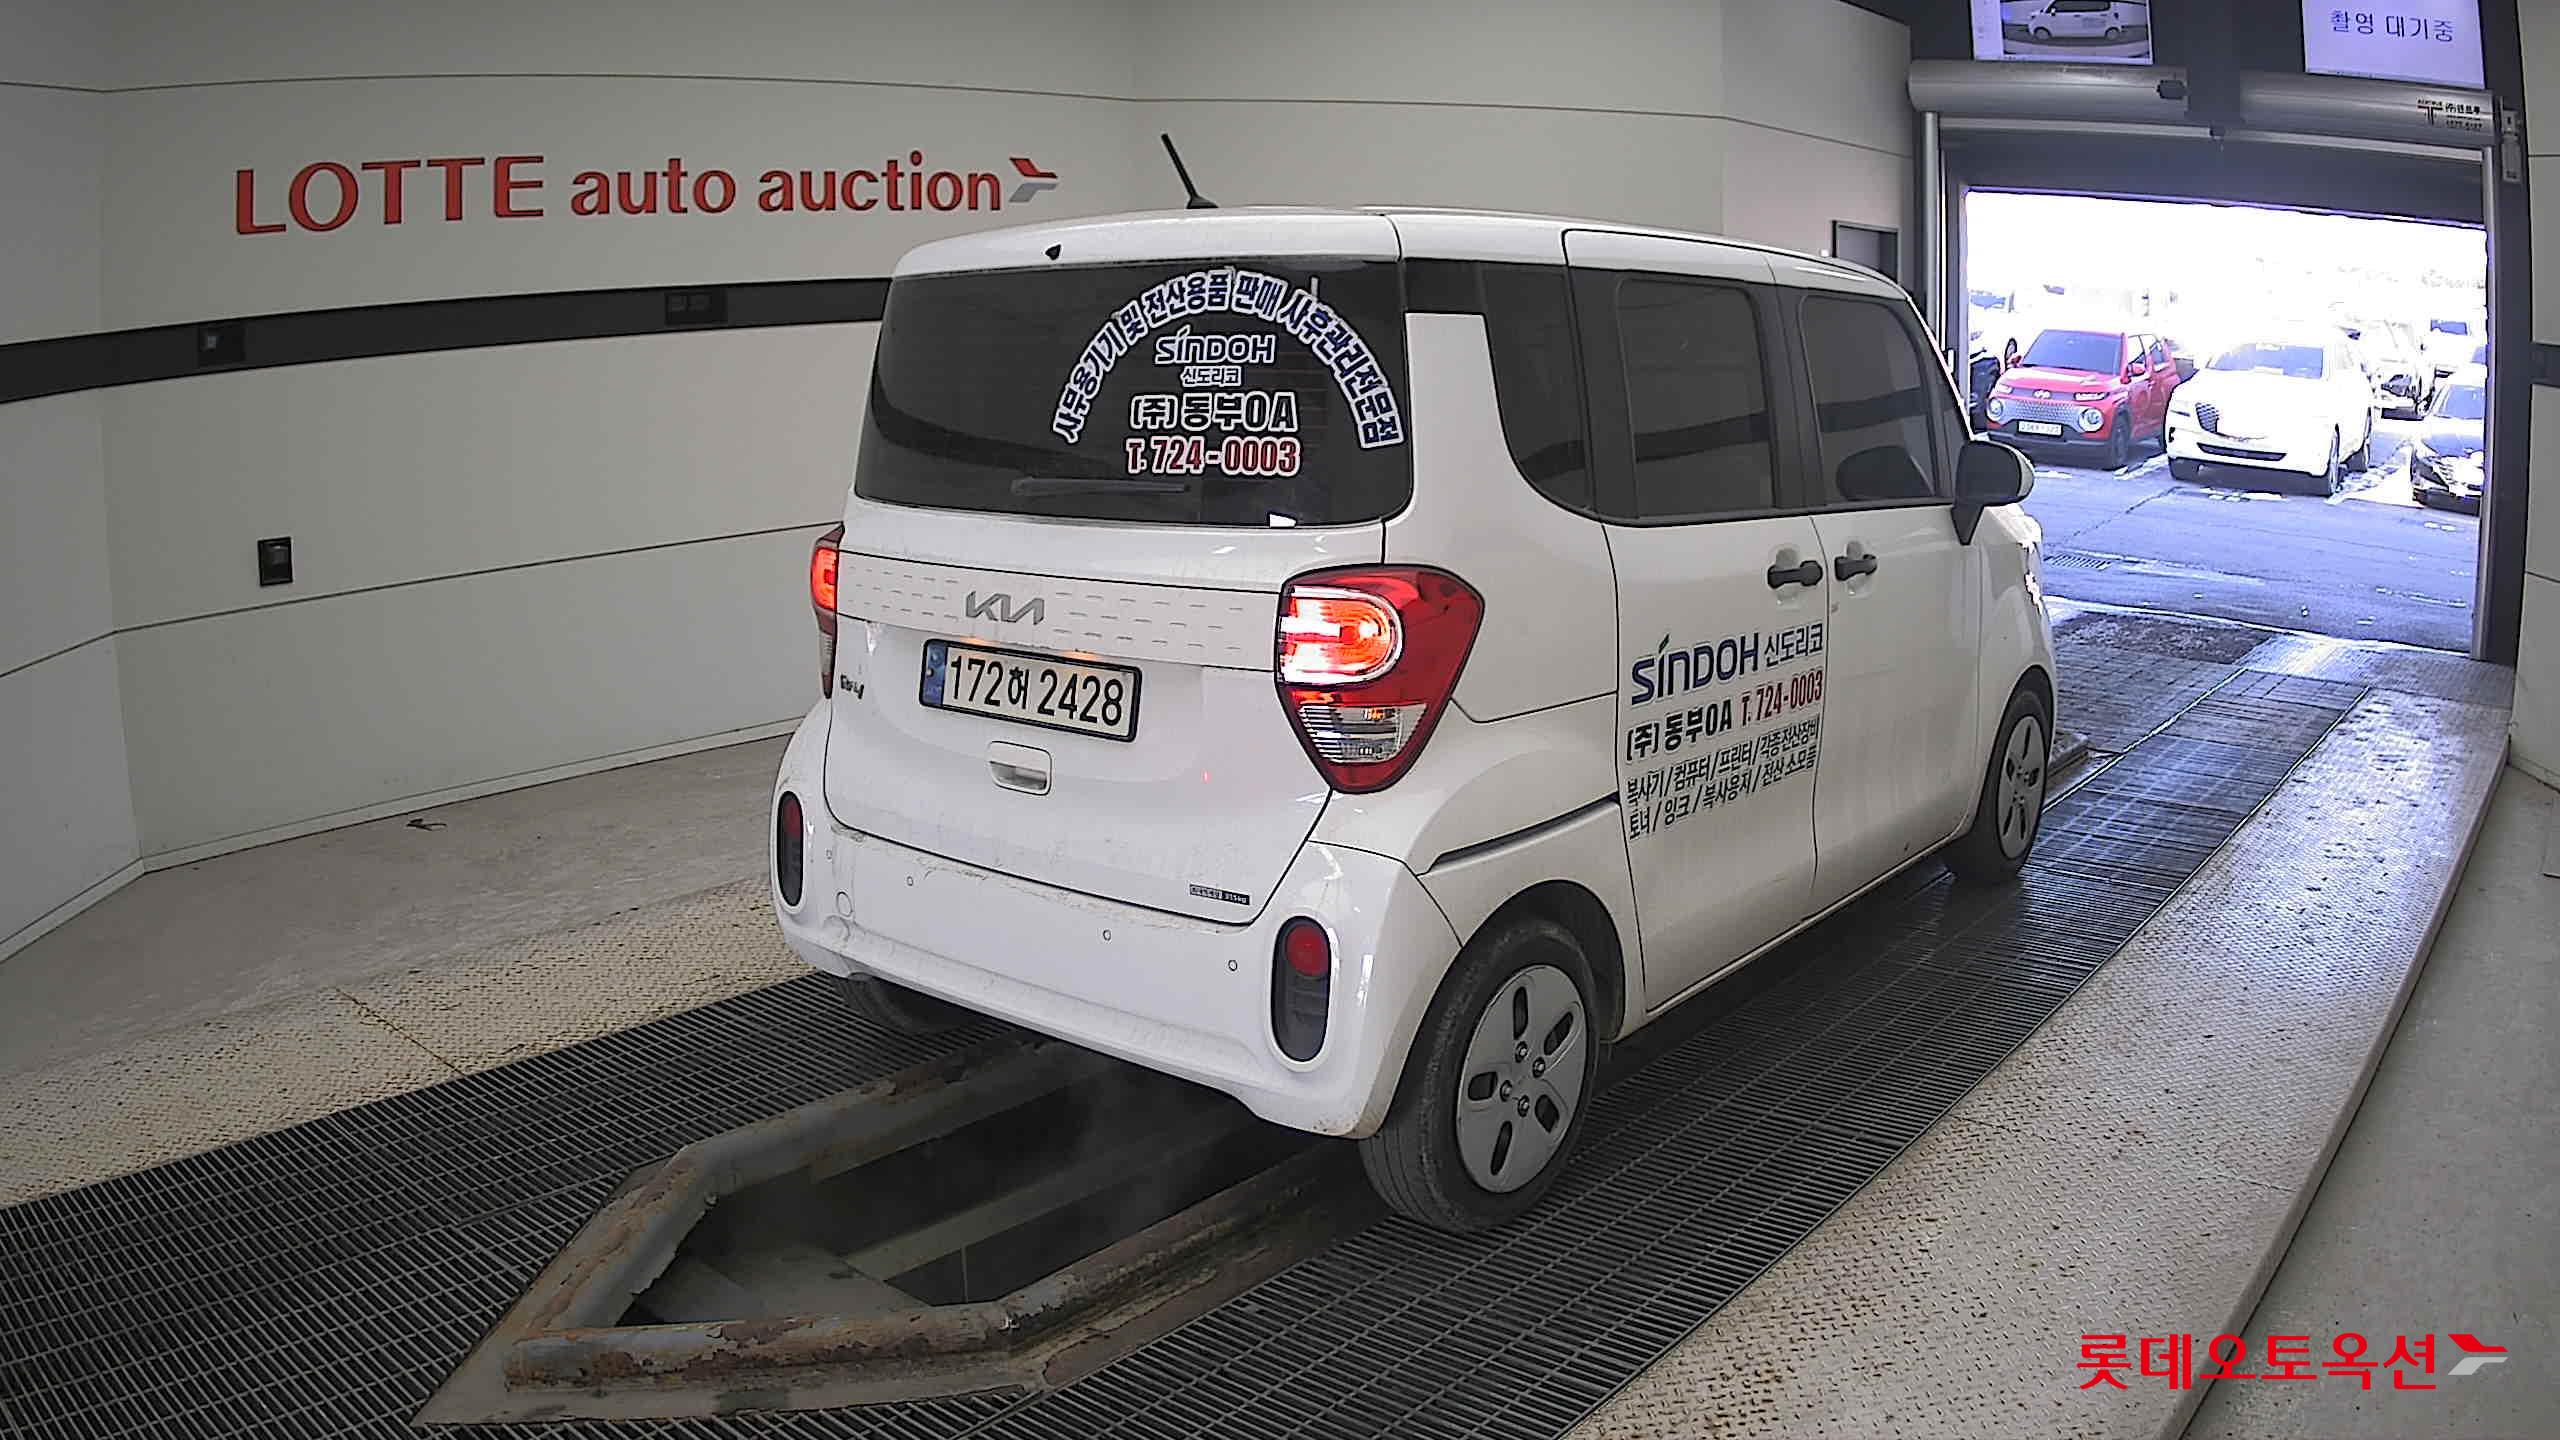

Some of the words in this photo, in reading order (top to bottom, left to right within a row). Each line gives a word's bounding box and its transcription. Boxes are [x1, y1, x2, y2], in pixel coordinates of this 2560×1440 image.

[2331, 9, 2374, 35] 촬영
[2385, 15, 2453, 42] 대기중
[235, 154, 545, 235] LOTTE
[569, 157, 737, 218] auto
[757, 150, 1002, 213] auction
[1052, 321, 1126, 444] 사무용기기
[1113, 300, 1148, 347] 및
[1141, 268, 1233, 328] 전산용품
[1232, 270, 1288, 321] 판매
[1180, 365, 1242, 387] 신도리코
[965, 590, 1045, 626] KIA
[1764, 623, 1823, 667] 신도리코
